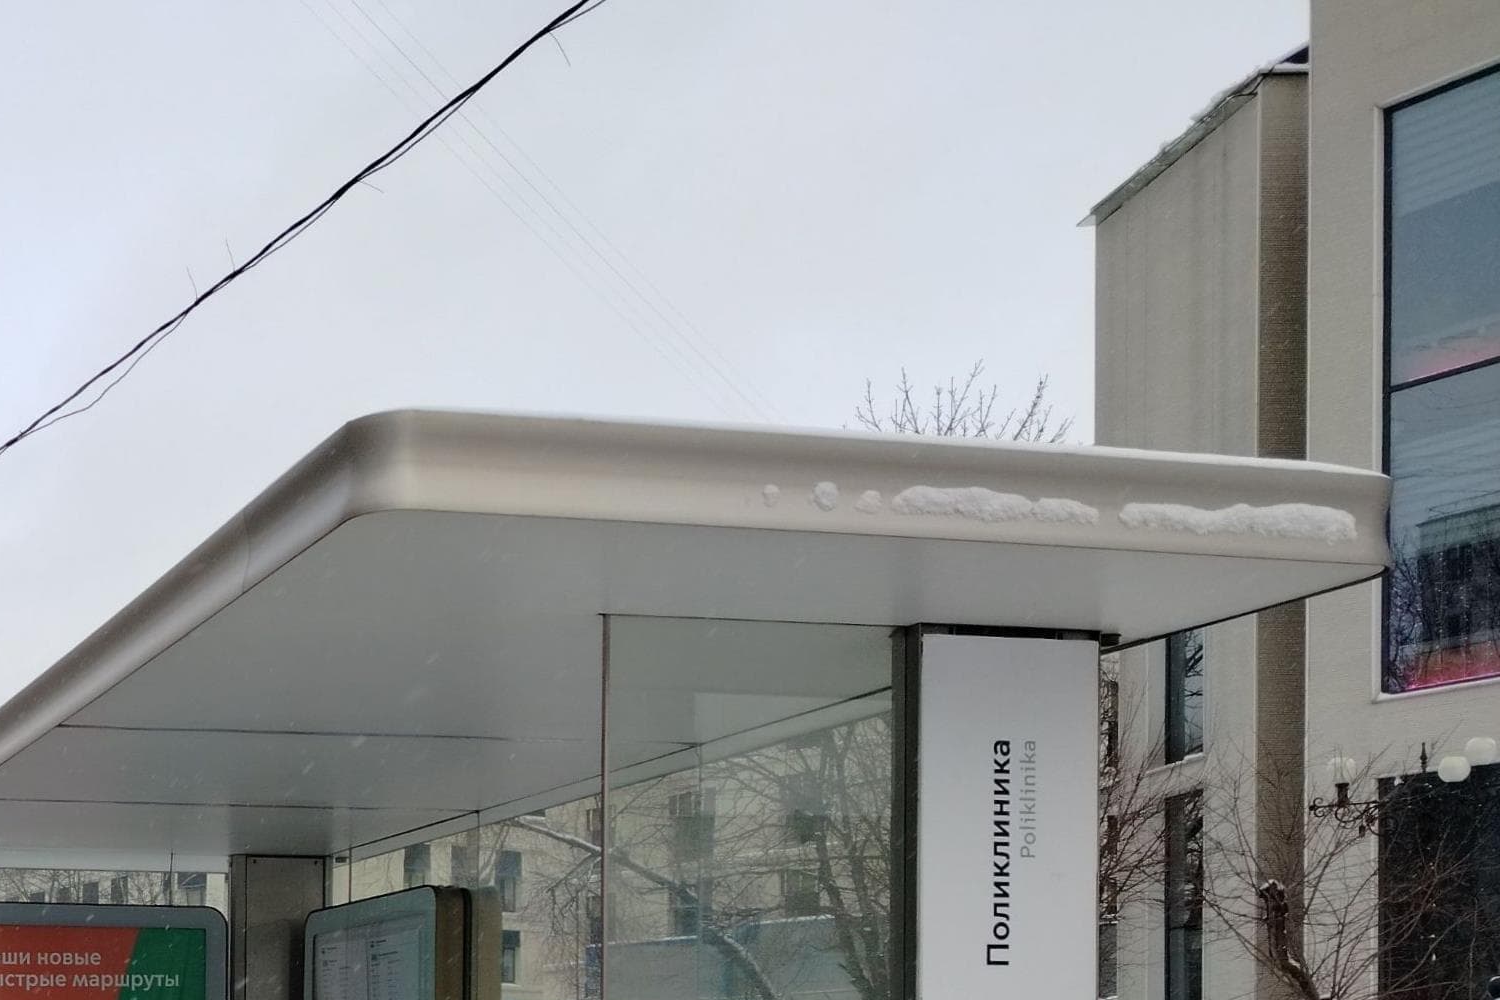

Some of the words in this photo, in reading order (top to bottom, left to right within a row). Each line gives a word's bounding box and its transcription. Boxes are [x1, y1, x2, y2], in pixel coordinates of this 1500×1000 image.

[1018, 740, 1036, 858] Poliklinika
[986, 740, 1010, 966] Поликлиника
[37, 951, 101, 965] новые
[72, 972, 180, 991] маршруты
